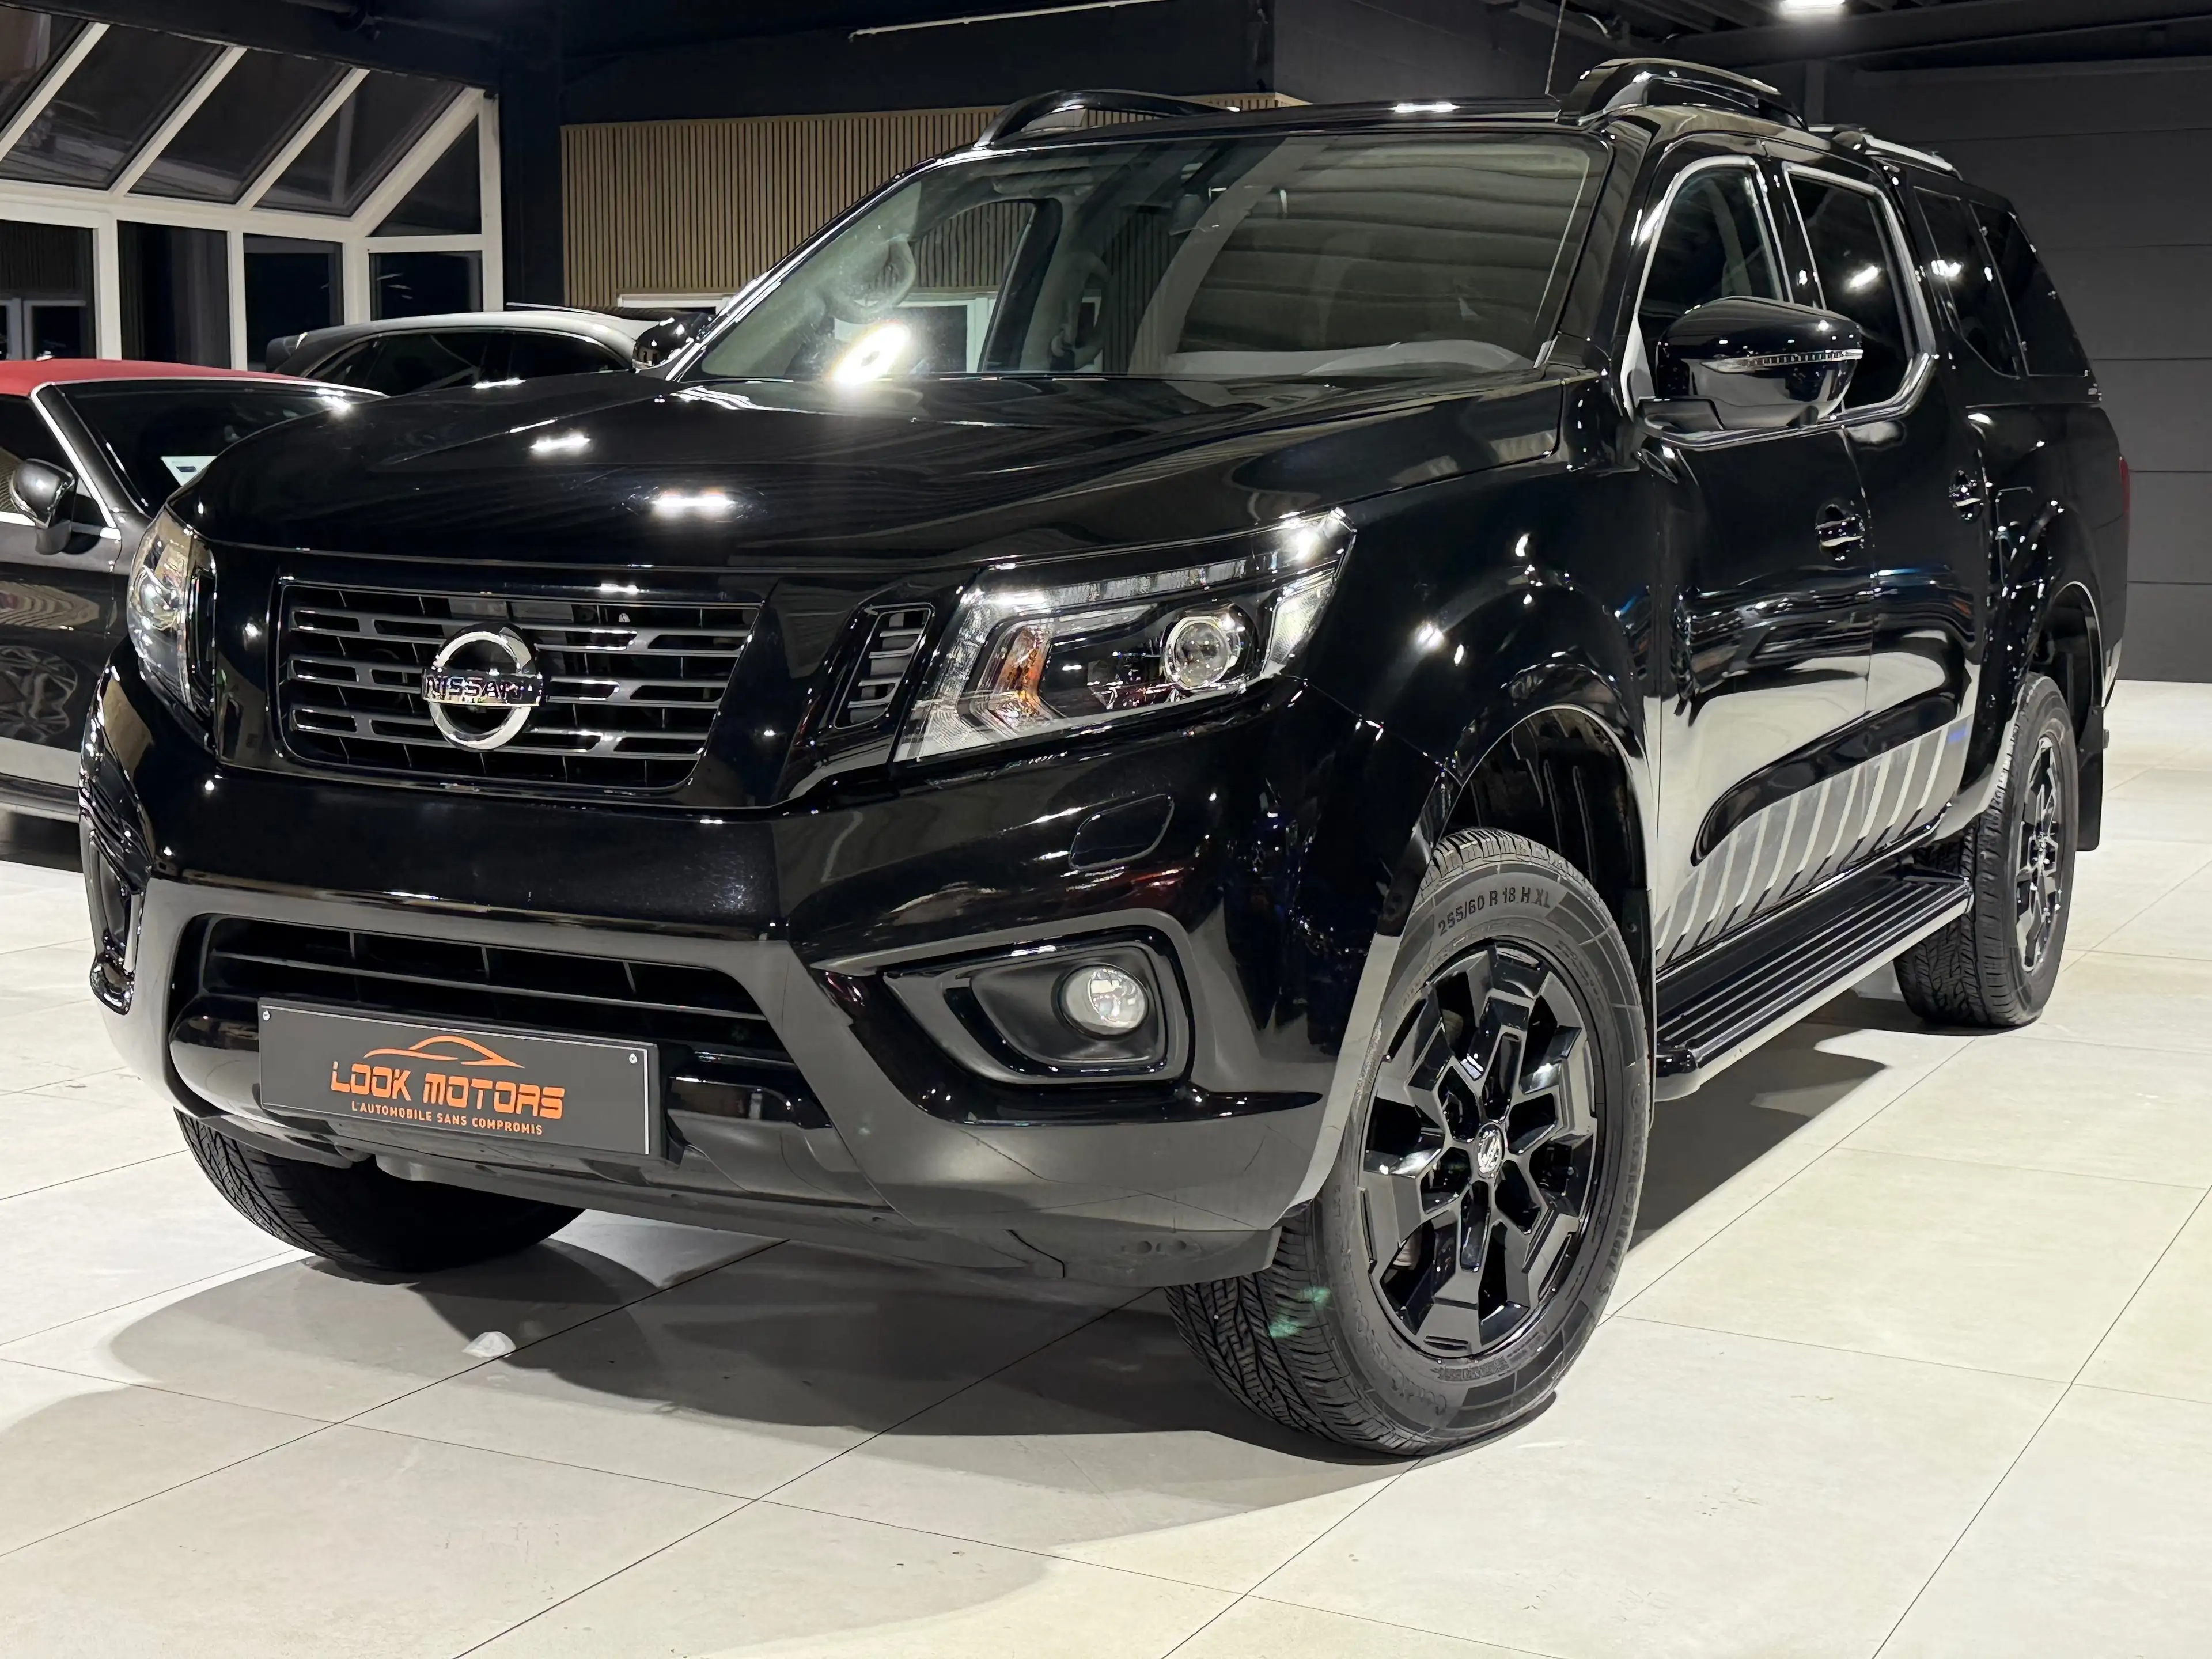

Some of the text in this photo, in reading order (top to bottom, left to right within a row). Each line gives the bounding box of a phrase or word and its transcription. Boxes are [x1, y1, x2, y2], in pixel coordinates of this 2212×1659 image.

[425, 674, 524, 702] NISSAN
[1438, 887, 1551, 937] 255/60 R 18 H XL
[331, 1060, 566, 1120] LOOK MOTORS
[437, 1112, 467, 1127] SANS
[471, 1116, 543, 1136] COMPROMIS
